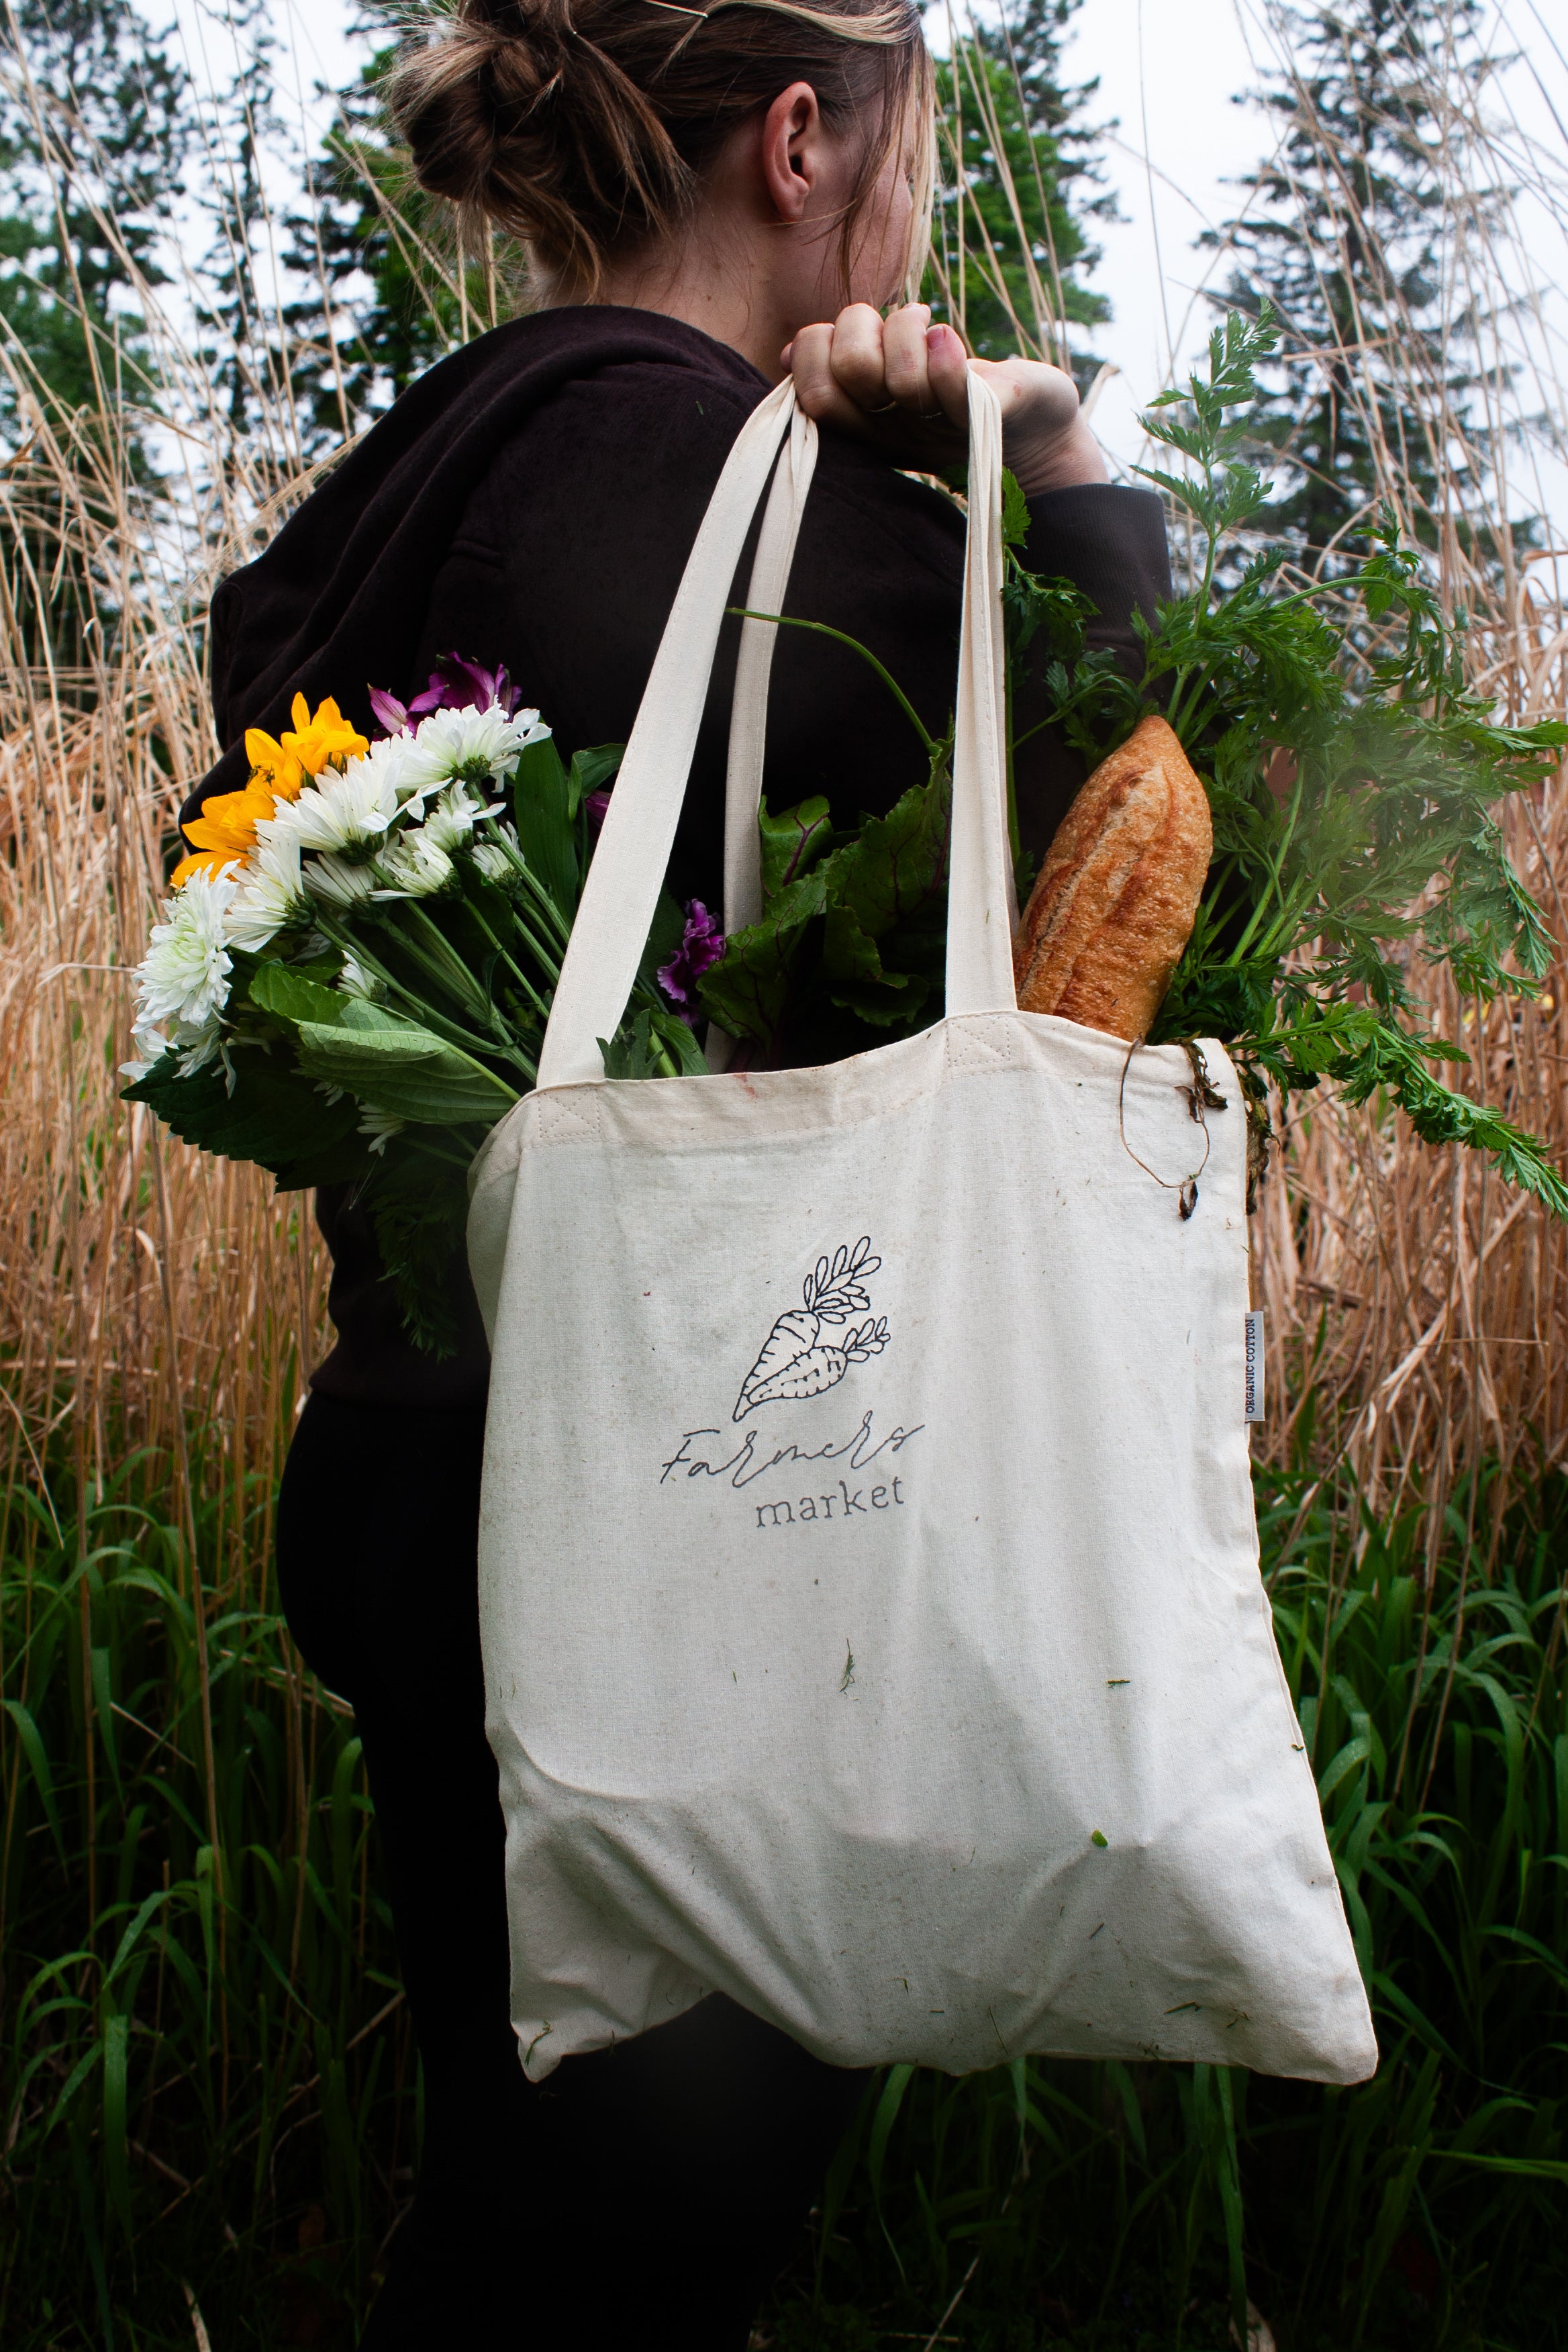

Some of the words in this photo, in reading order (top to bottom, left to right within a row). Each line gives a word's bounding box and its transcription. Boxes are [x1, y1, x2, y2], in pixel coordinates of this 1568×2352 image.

[1244, 1318, 1255, 1363] COTTON
[1244, 1365, 1255, 1414] ORGANIC
[660, 1410, 926, 1489] Farmers
[756, 1476, 905, 1528] market
